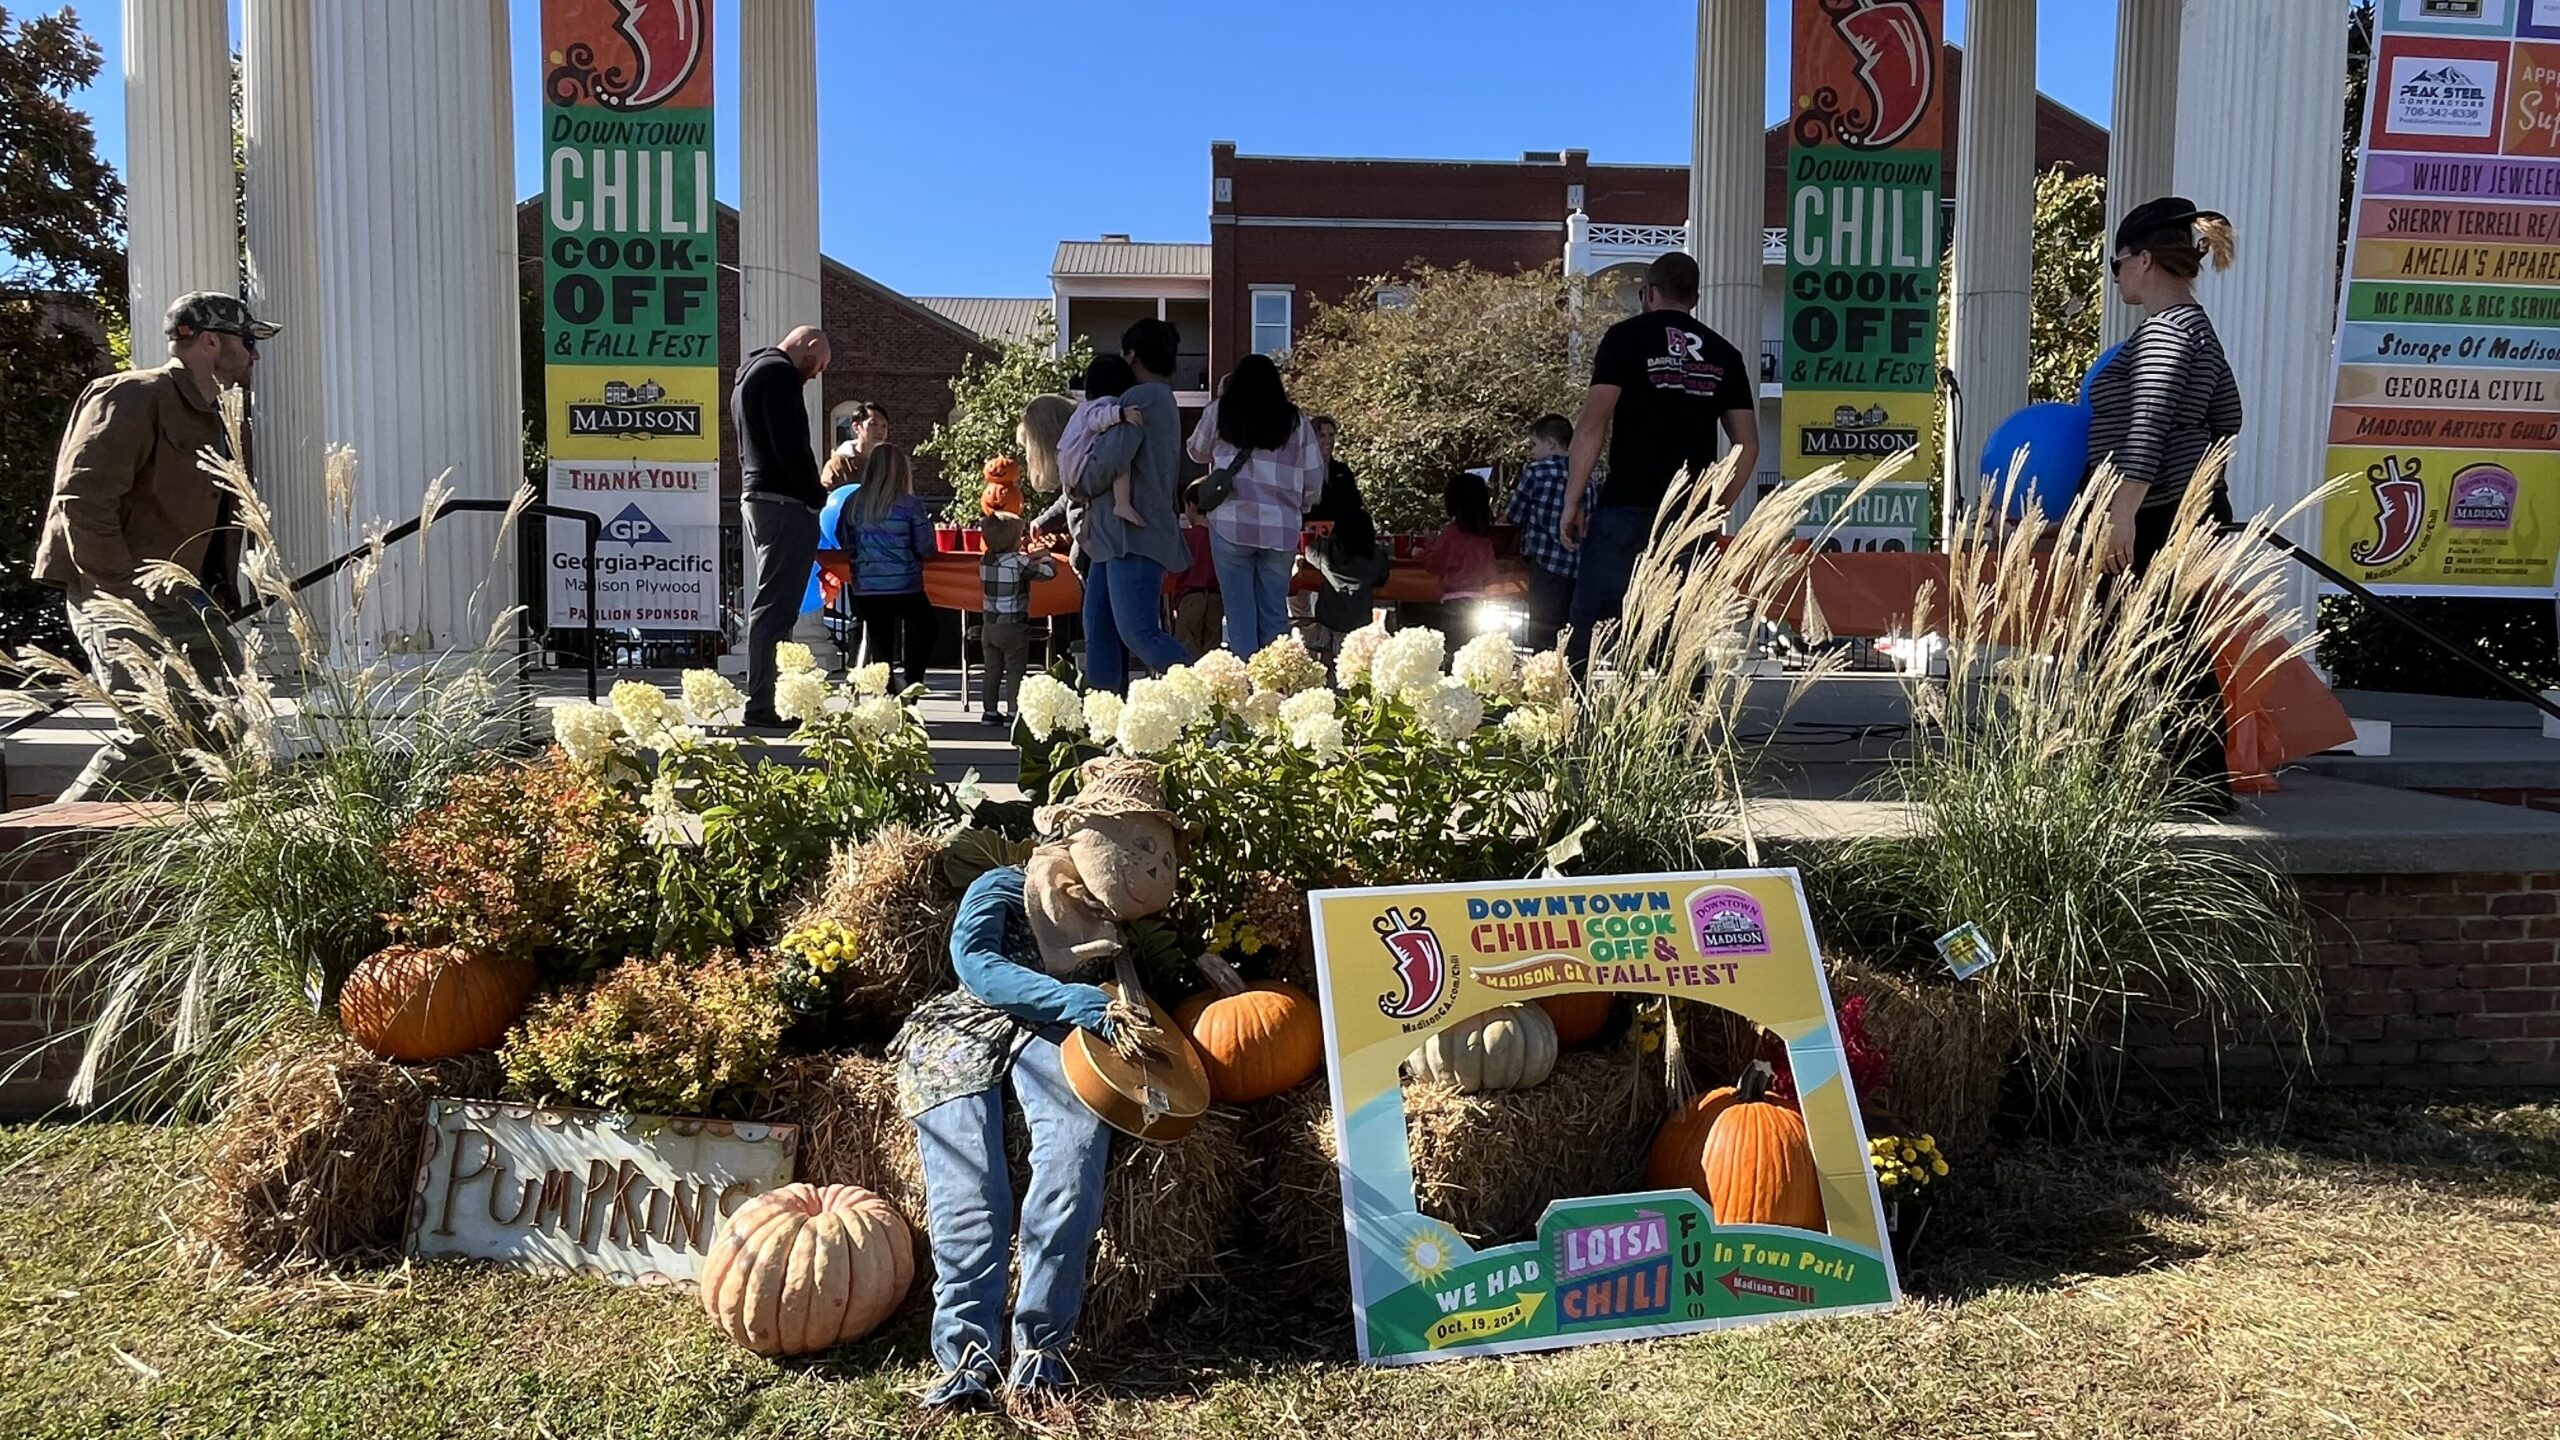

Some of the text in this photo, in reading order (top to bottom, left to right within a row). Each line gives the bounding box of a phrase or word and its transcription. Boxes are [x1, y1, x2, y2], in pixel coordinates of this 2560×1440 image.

[2522, 66, 2560, 88] APP
[2399, 98, 2484, 107] CONTRACTORS
[2400, 85, 2486, 100] PEAK STEEL
[551, 114, 706, 146] DOWNTOWN
[1796, 155, 1934, 186] DOWNTOWN
[550, 146, 708, 234] CHILI
[1793, 185, 1934, 268] CHILI
[2387, 207, 2560, 242] SHERRY TERRELL RE/
[551, 236, 709, 271] COOK-
[2401, 247, 2560, 280] AMELIA'S APPARE
[553, 273, 708, 325] OFF
[1792, 270, 1932, 303] COOK-
[2374, 292, 2398, 314] MC
[2403, 292, 2453, 316] PARKS
[2460, 294, 2472, 316] &
[2477, 295, 2504, 318] REC
[554, 329, 712, 358] & FALL FEST
[1792, 305, 1930, 354] OFF
[2377, 333, 2451, 364] Storage
[2458, 336, 2486, 358] Of
[1790, 357, 1930, 385] & FALL FEST
[2384, 377, 2545, 402] GEORGIA CIVIL
[573, 409, 697, 432] MADISON
[2356, 417, 2558, 441] MADISON ARTISTS GUILD
[1805, 432, 1915, 453] MADISON
[568, 468, 698, 491] THANK YOU!
[1801, 494, 1918, 523] ATRDAY
[2456, 507, 2508, 519] MADISON
[609, 520, 651, 540] GP
[565, 577, 701, 595] Maison Plywood
[569, 607, 699, 622] PAILION SPONSOR
[1466, 892, 1671, 920] DOWNTOWN
[1695, 899, 1759, 919] DOWNTOWN
[1470, 919, 1582, 953] CHILI
[1585, 913, 1677, 938] COOK
[1704, 931, 1763, 946] MADISON
[1589, 936, 1679, 962] OFF &
[1485, 963, 1585, 988] MADISON, GA
[1595, 962, 1739, 987] FALL FEST
[1402, 954, 1461, 1034] MadisonGA.com/Chili
[1566, 1222, 1663, 1272] LOTSA
[1713, 1242, 1856, 1282] In Town Park!
[1435, 1259, 1541, 1314] WE HAD
[1563, 1264, 1669, 1320] CHILI
[1437, 1319, 1468, 1339] Oct.
[1494, 1306, 1522, 1329] 2024
